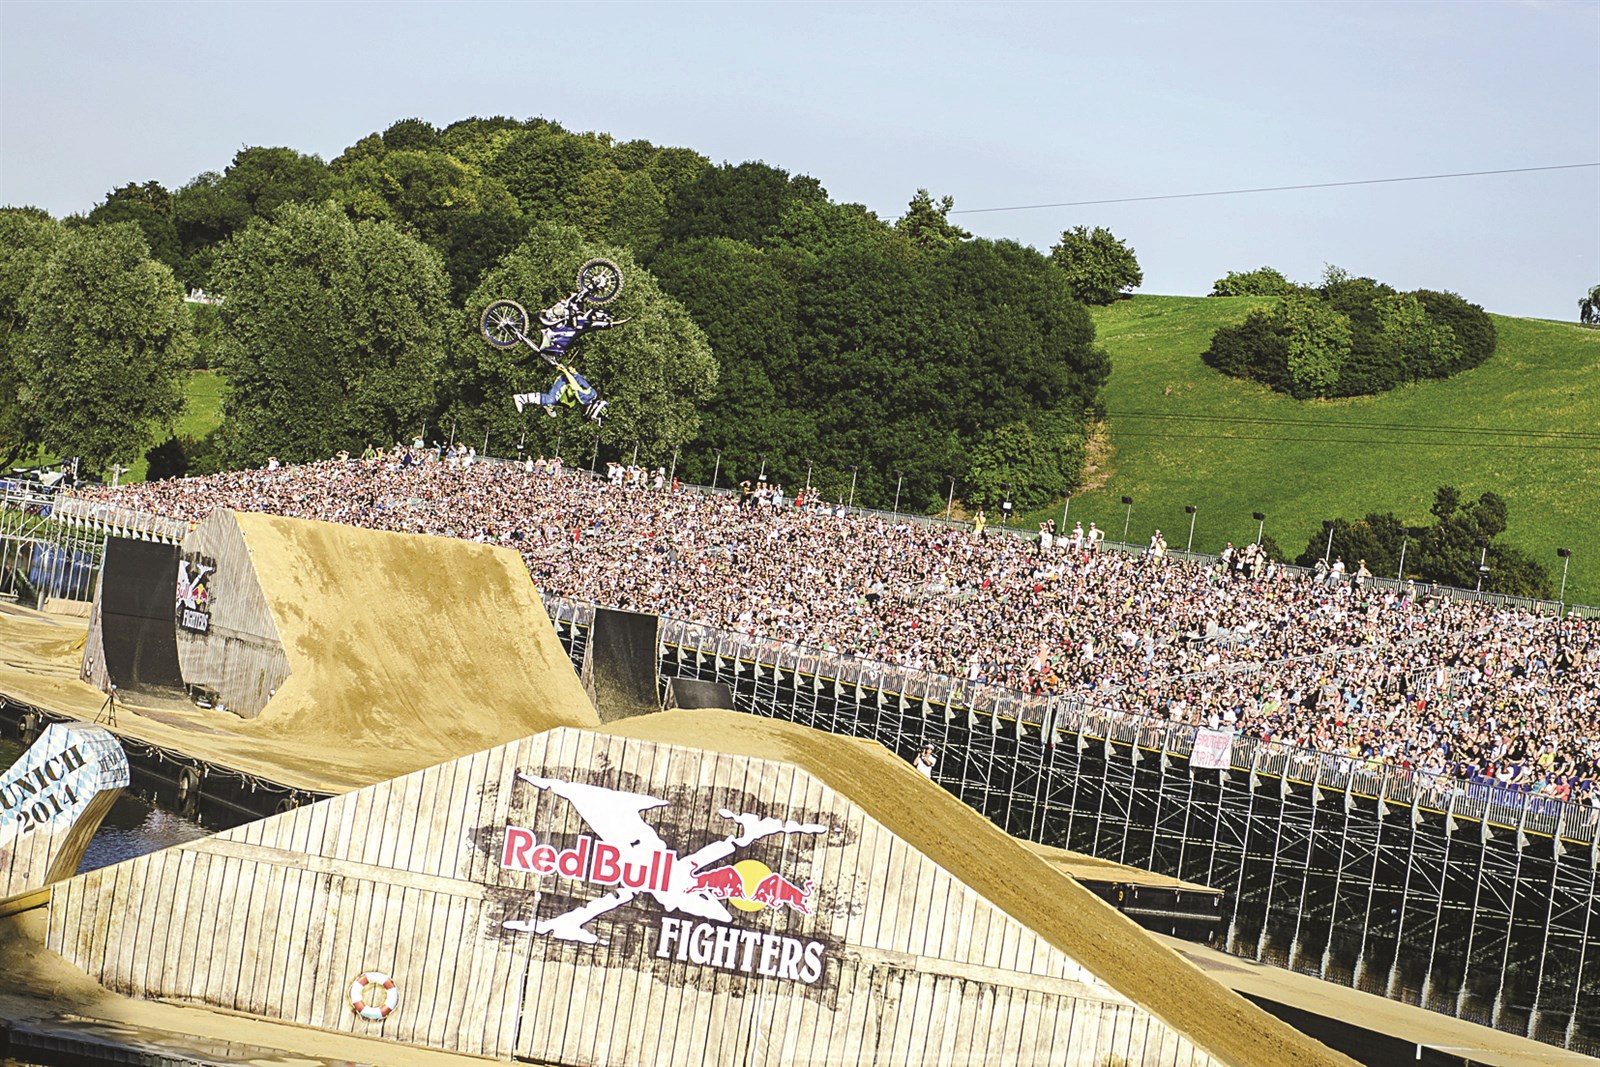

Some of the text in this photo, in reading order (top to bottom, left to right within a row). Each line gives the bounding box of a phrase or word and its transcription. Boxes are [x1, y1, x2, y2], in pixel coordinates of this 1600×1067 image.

[0, 744, 86, 812] UNICH
[16, 784, 79, 834] 2014
[504, 828, 673, 892] Red Bull
[656, 916, 825, 984] FIGHTERS
